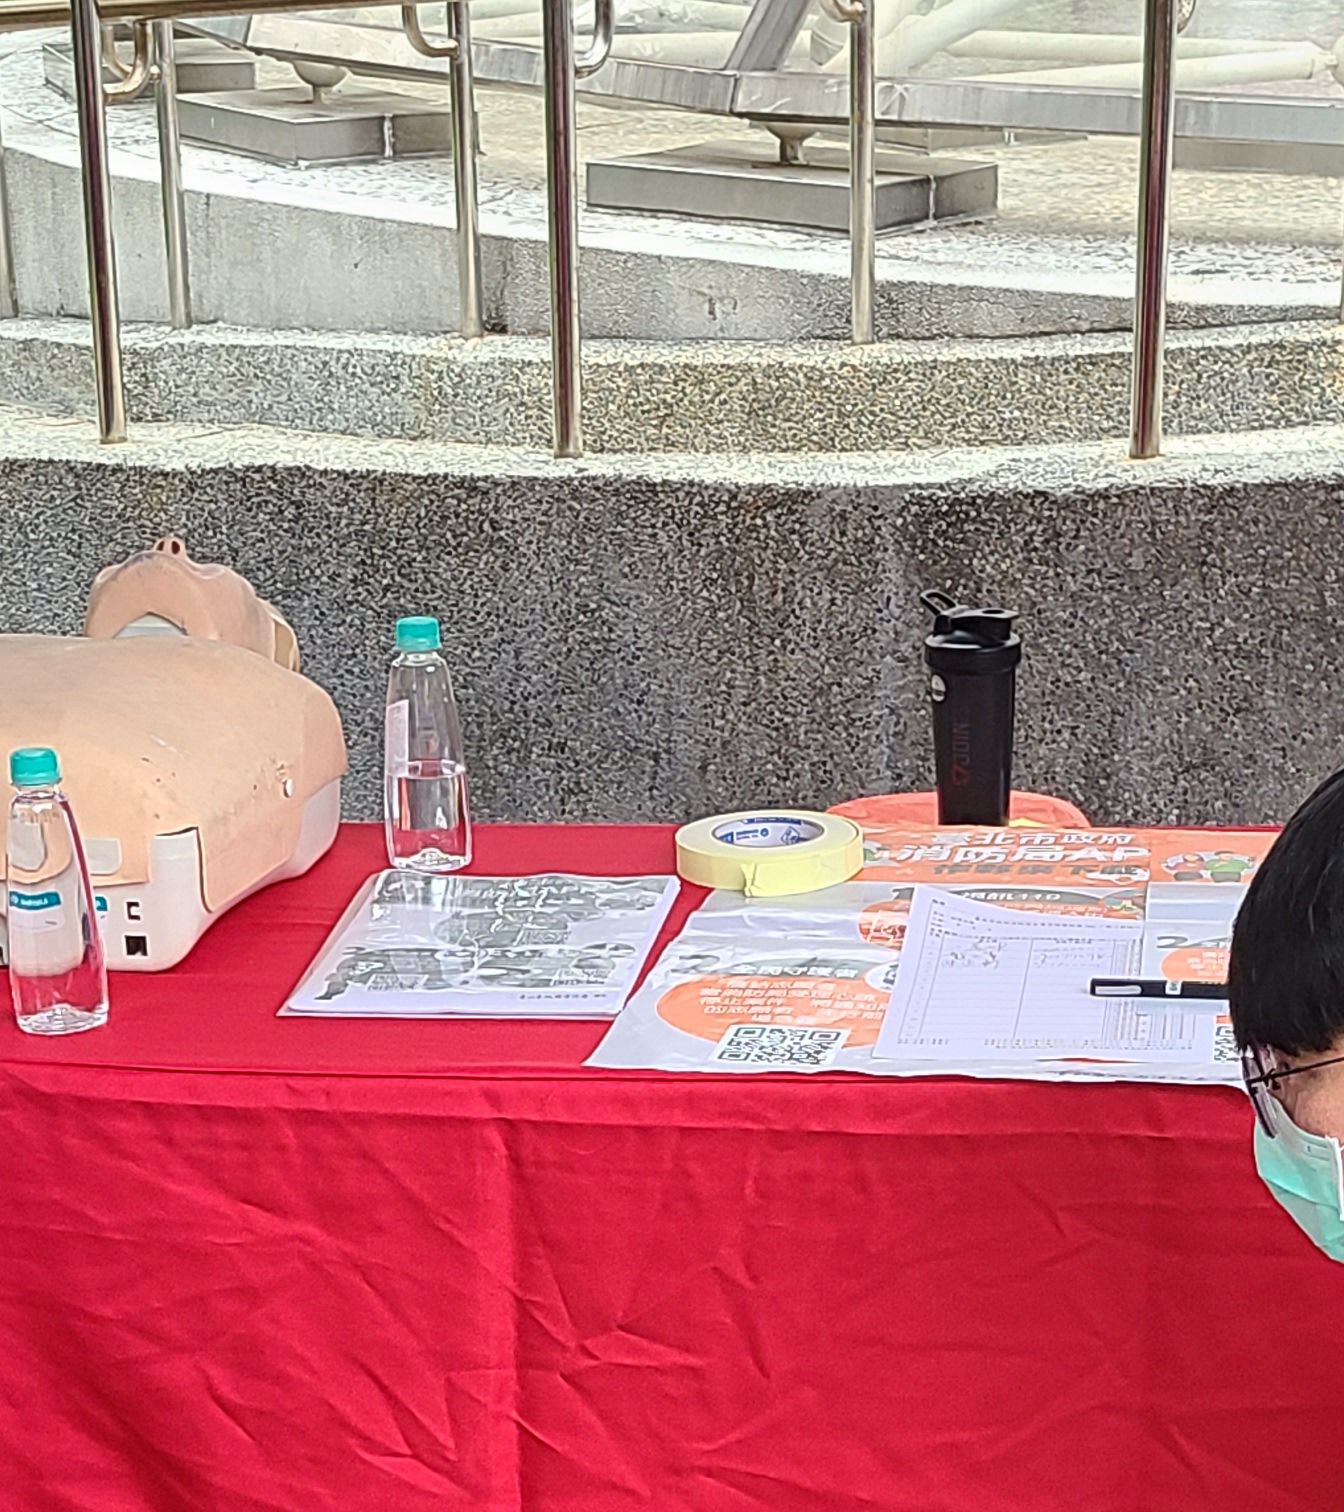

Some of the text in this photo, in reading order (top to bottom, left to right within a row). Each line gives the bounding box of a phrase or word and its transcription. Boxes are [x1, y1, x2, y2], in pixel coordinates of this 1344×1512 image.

[931, 832, 1136, 846] 臺北市政府
